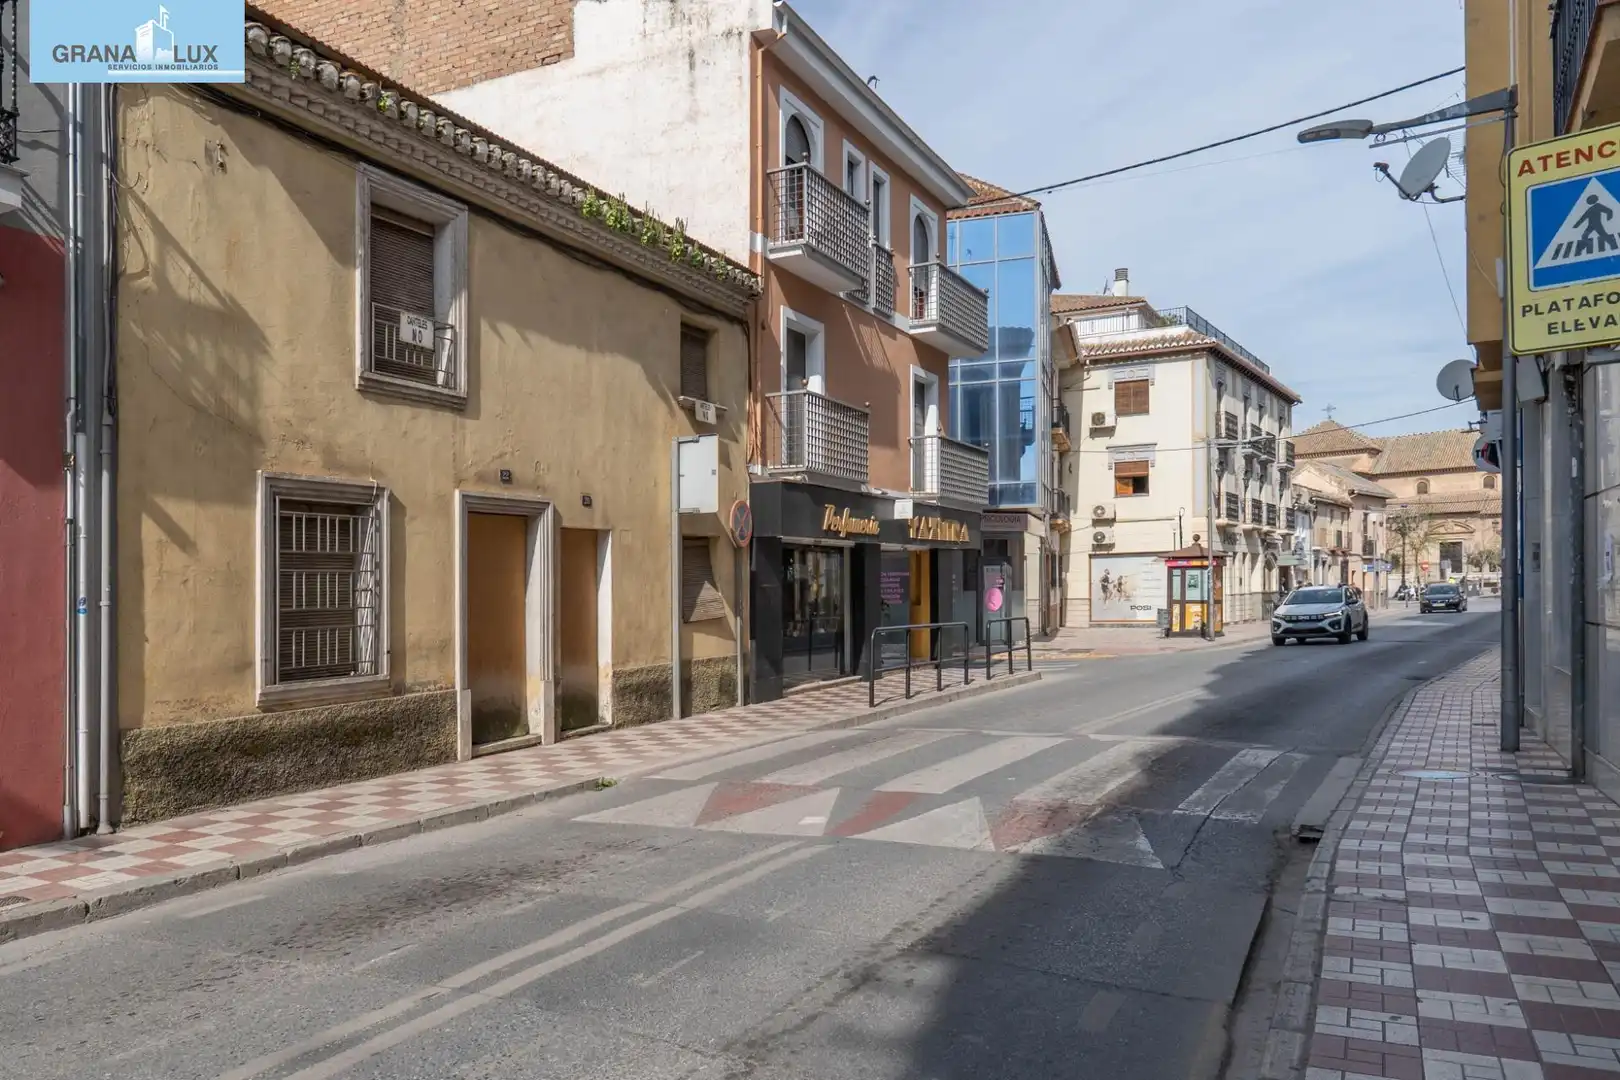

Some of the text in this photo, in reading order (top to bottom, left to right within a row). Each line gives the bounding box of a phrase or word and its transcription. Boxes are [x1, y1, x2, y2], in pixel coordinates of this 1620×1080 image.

[1517, 140, 1620, 177] ATENC
[1521, 291, 1620, 318] PLATAFO
[1547, 314, 1620, 335] ELEVA
